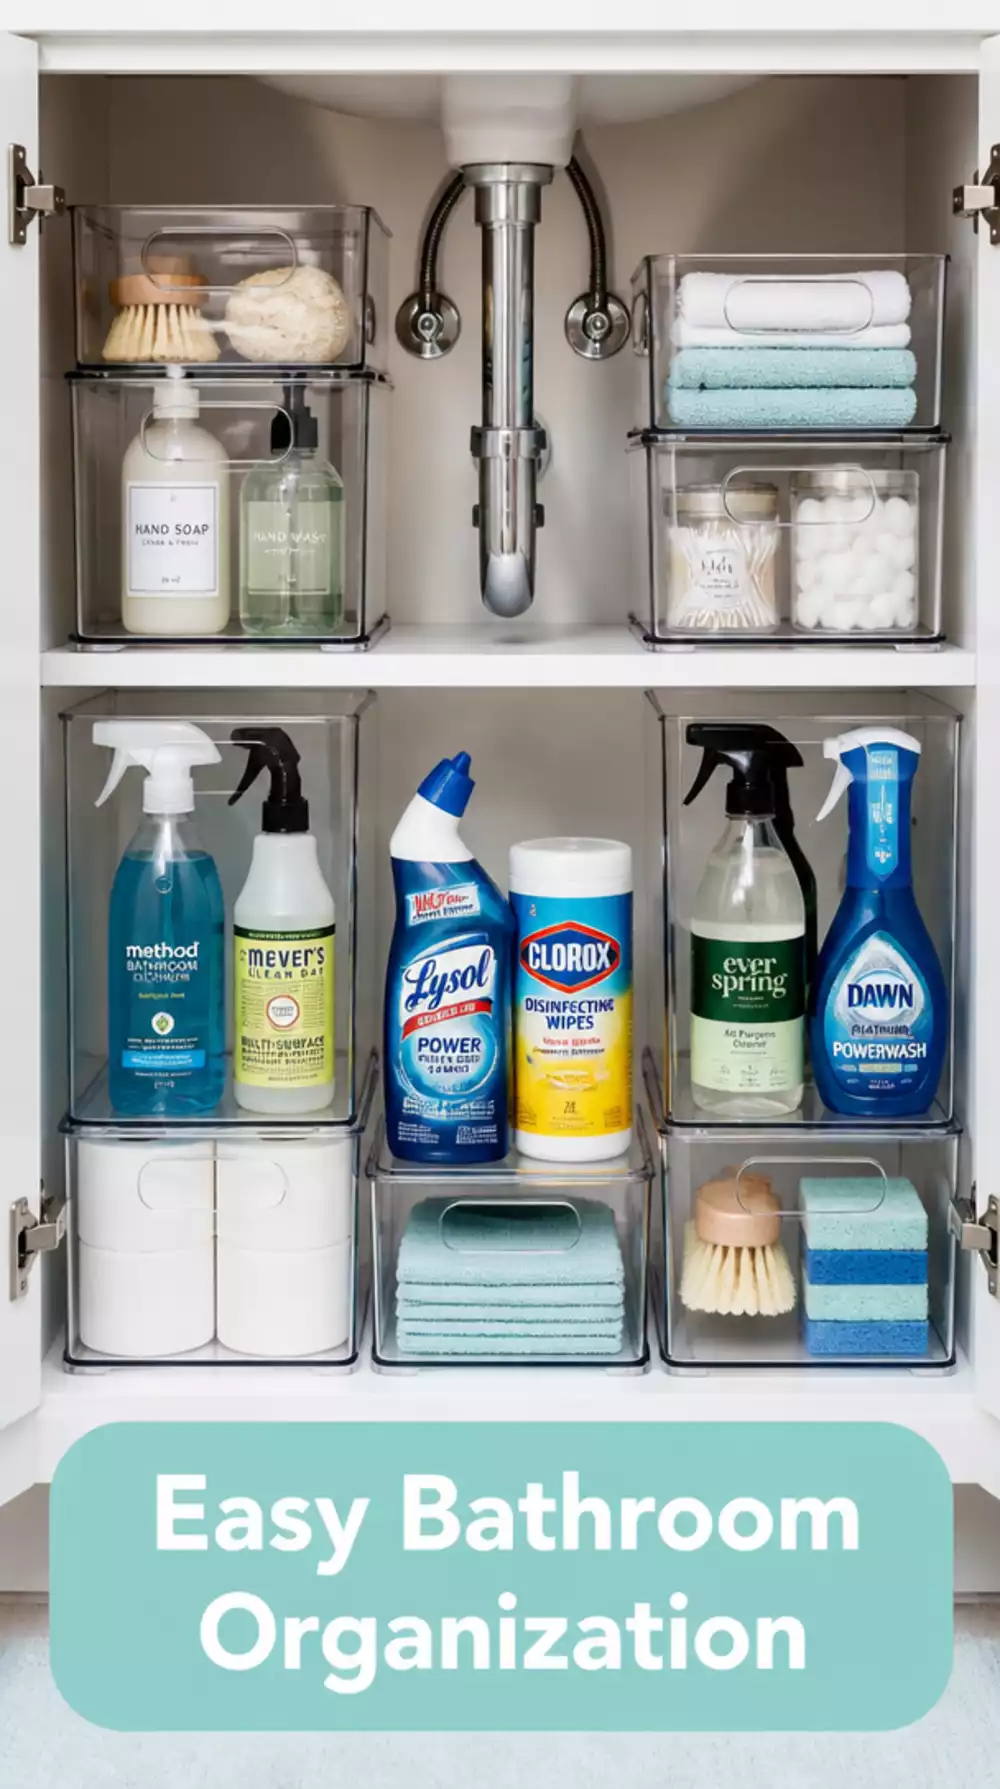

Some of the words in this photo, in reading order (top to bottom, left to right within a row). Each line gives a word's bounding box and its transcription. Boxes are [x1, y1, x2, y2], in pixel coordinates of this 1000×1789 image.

[136, 524, 169, 535] HAND
[175, 524, 209, 535] SOAP
[126, 941, 199, 958] method
[528, 942, 610, 972] CLOROX
[723, 957, 777, 975] ever
[404, 948, 491, 1012] Lysol
[711, 973, 788, 998] spring
[848, 984, 913, 1008] DAWN
[546, 1015, 594, 1030] WIPES
[418, 1037, 481, 1053] POWER
[833, 1042, 926, 1059] POWERWASH
